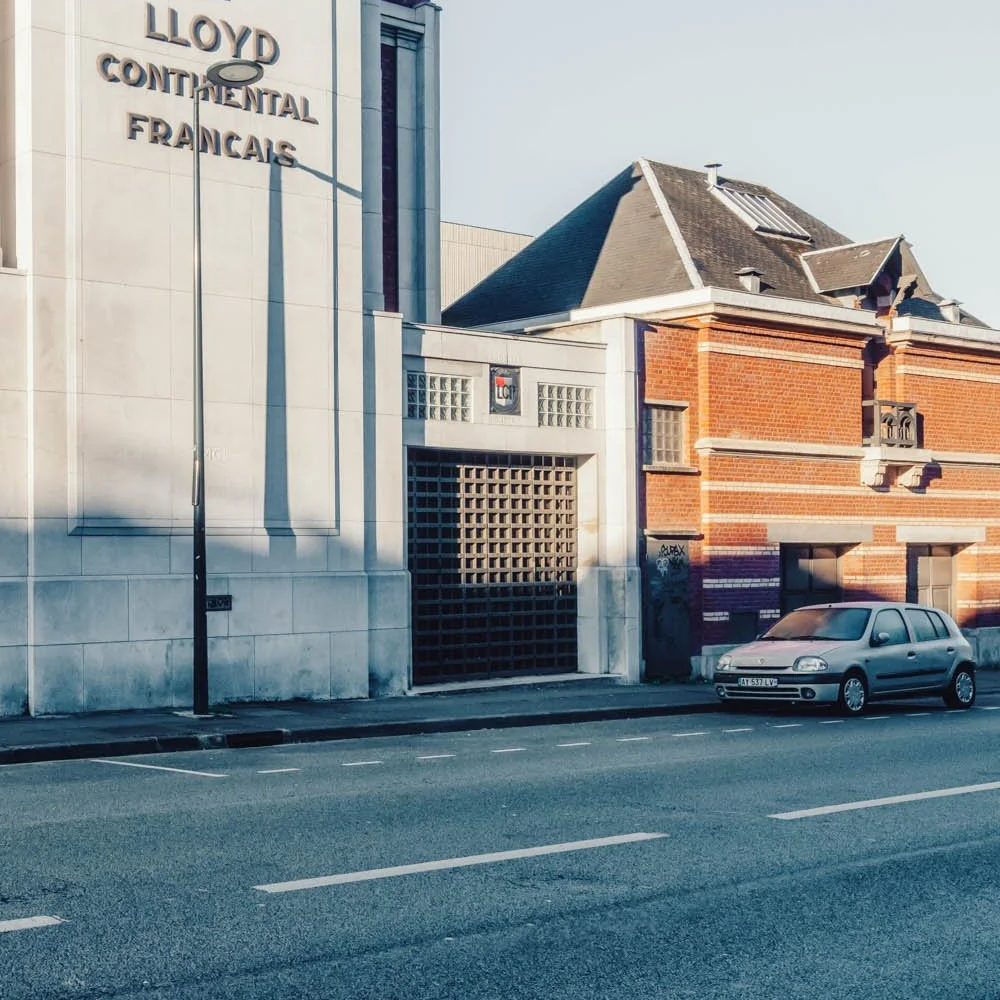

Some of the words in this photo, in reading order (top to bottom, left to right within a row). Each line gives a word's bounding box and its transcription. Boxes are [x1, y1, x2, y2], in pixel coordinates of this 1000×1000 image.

[144, 1, 281, 66] LLOYD
[96, 52, 319, 125] CONTINENTAL
[126, 111, 297, 167] FRANCAIS
